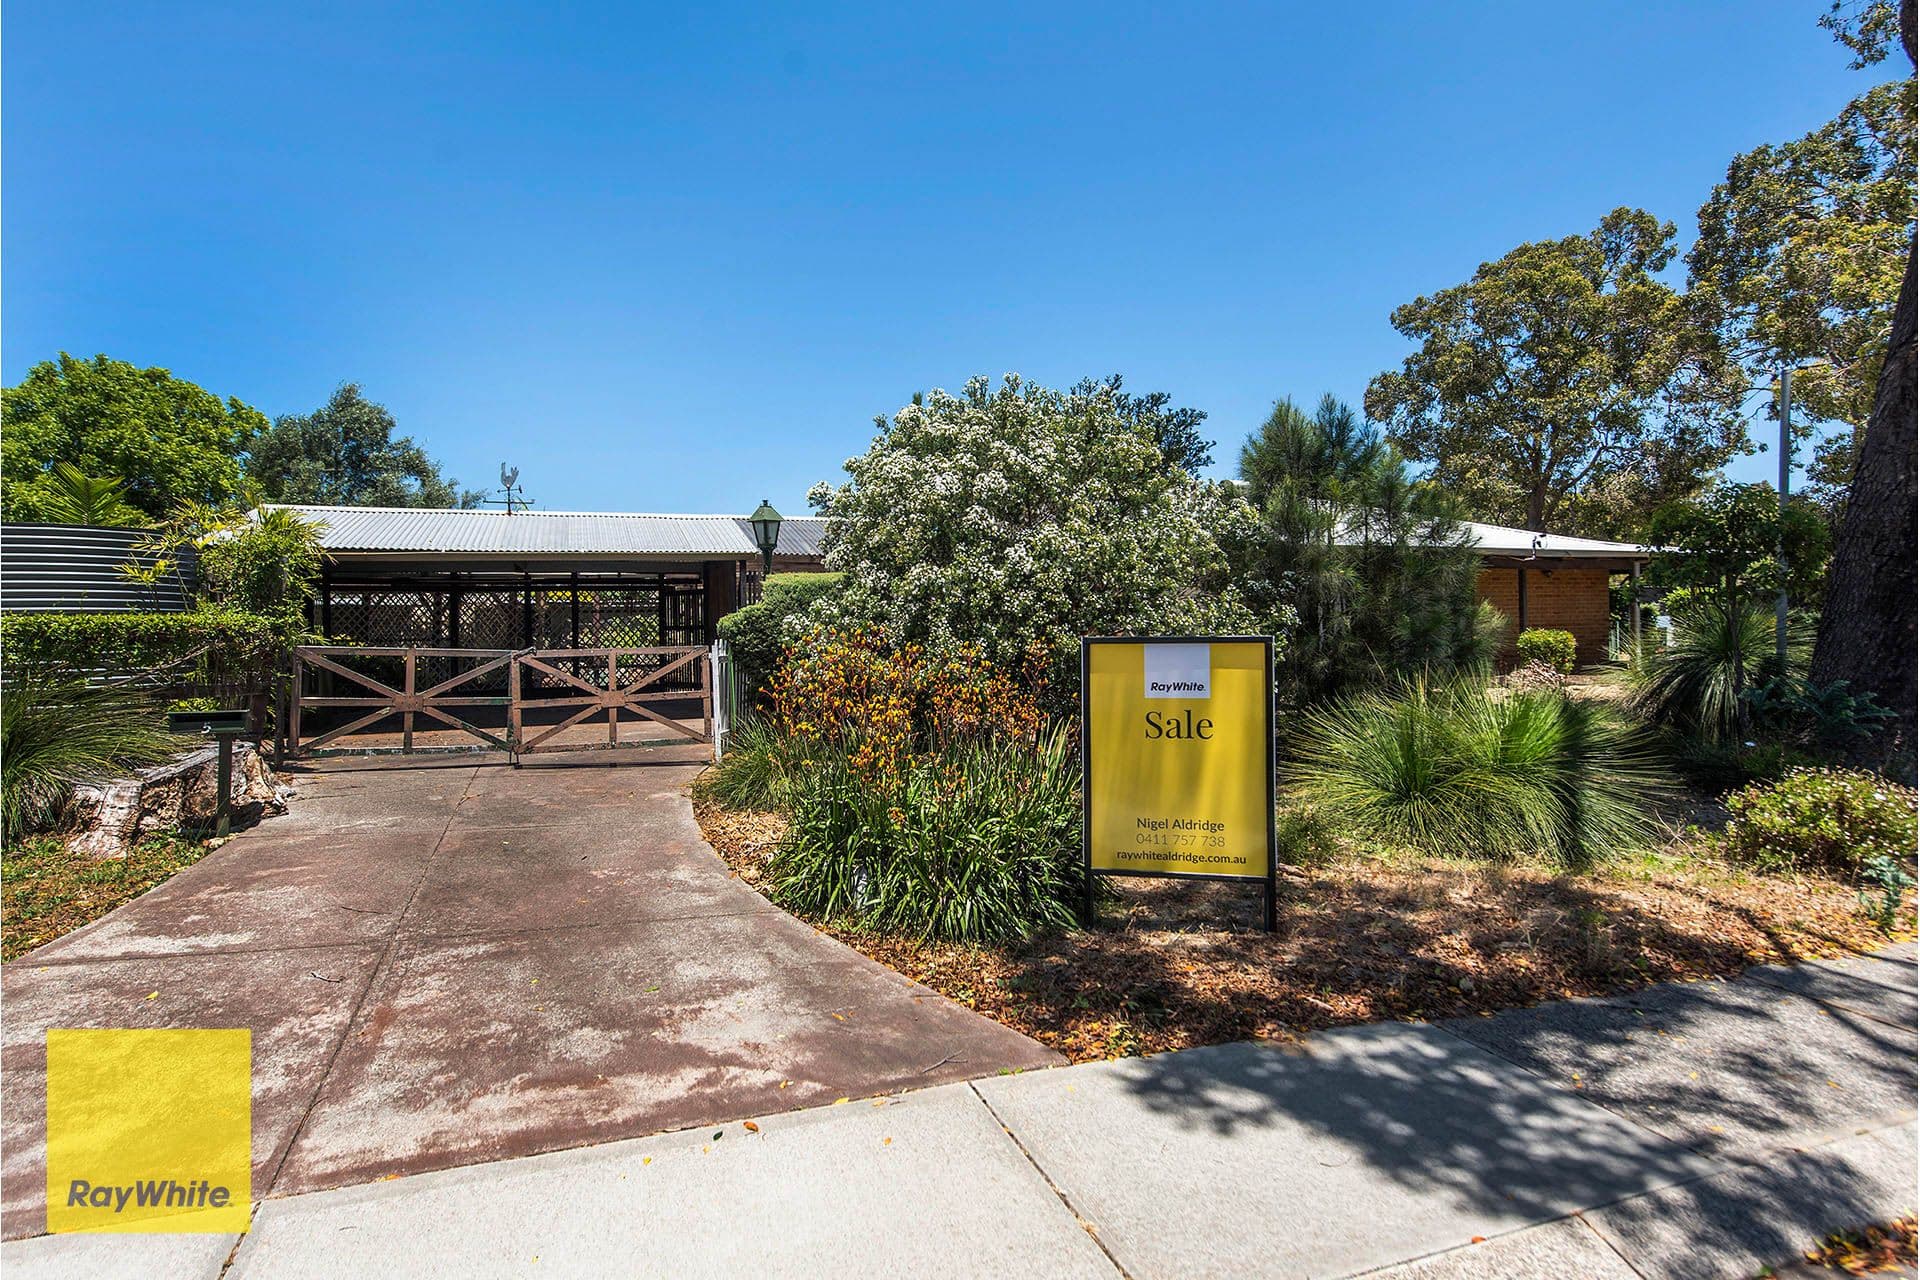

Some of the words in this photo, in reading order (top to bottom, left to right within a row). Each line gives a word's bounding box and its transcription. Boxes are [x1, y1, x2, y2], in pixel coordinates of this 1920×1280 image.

[1145, 709, 1214, 740] Sale
[1137, 817, 1168, 830] Nigel
[1172, 819, 1225, 832] Aldridge
[1136, 833, 1168, 846] 0411
[1173, 834, 1197, 847] 757
[1201, 835, 1225, 847] 738
[1116, 850, 1247, 865] raywhitealdridge.com.au
